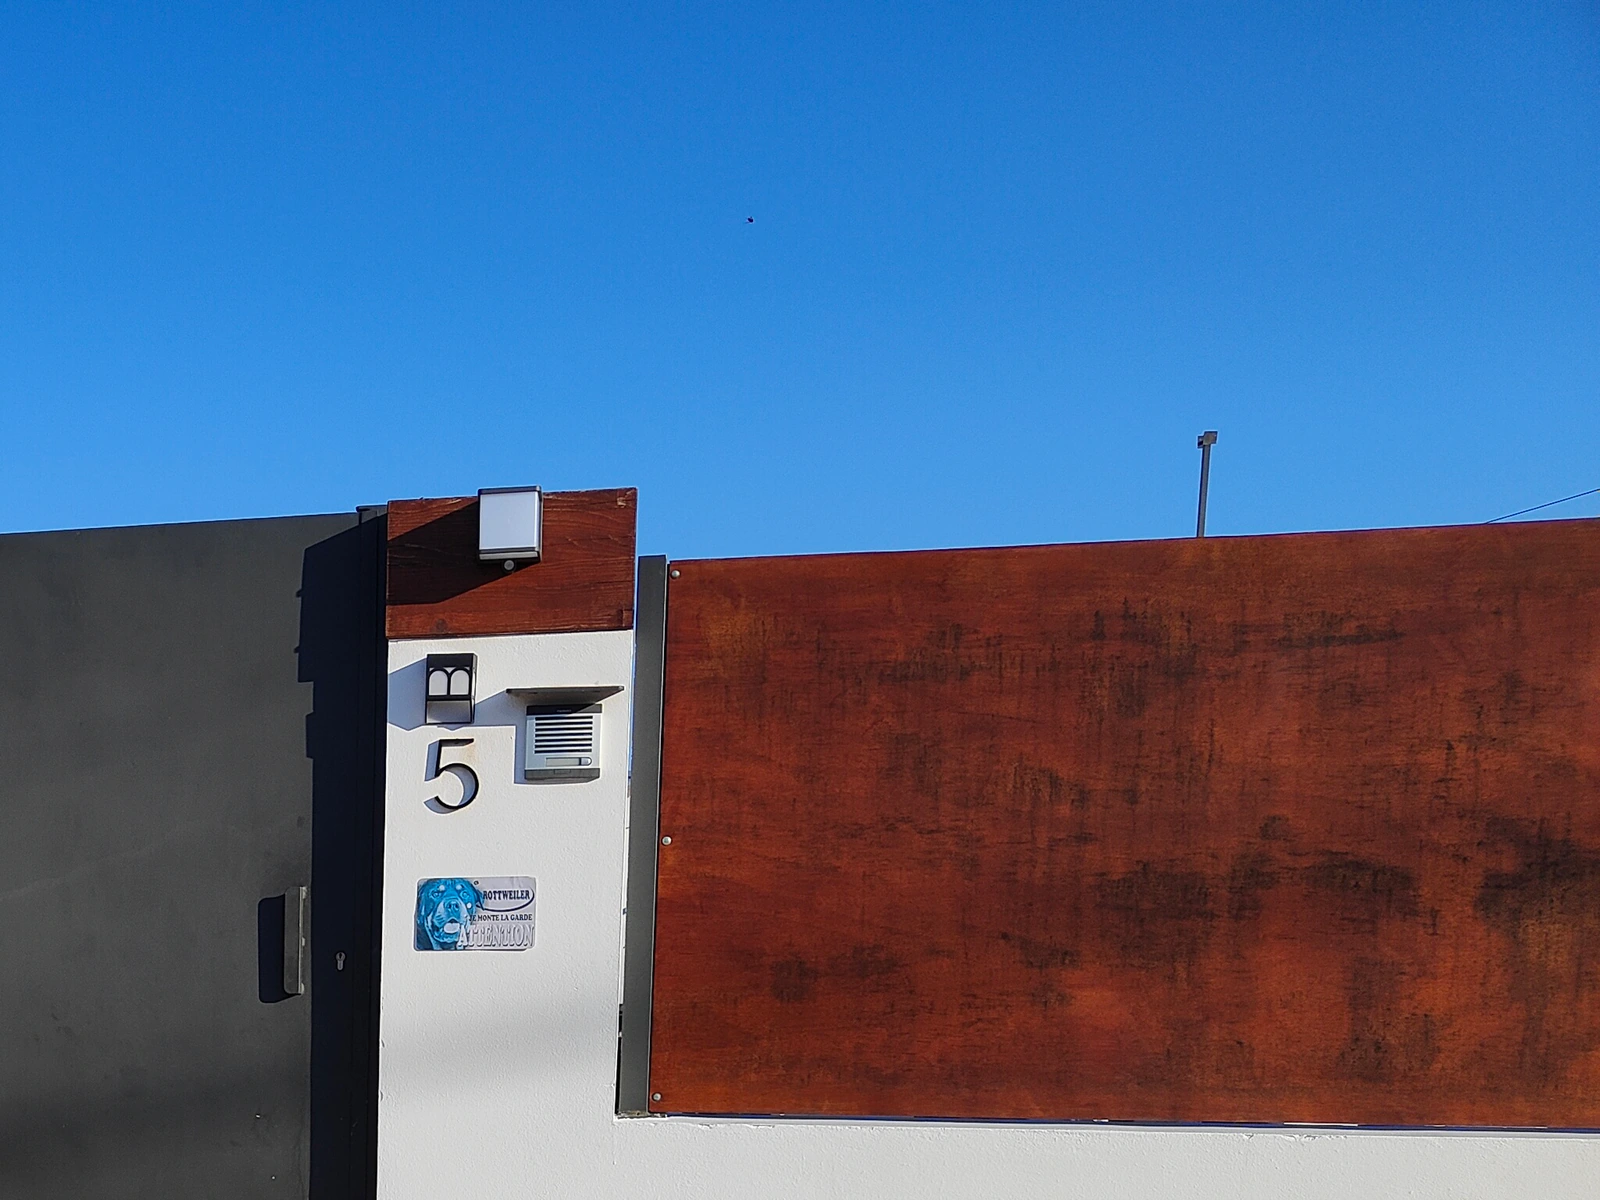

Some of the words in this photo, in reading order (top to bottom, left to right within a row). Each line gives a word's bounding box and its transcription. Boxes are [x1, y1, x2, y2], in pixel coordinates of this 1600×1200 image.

[434, 738, 480, 810] 5
[483, 890, 530, 900] ROTTWEILER
[458, 924, 534, 948] ATTENTION
